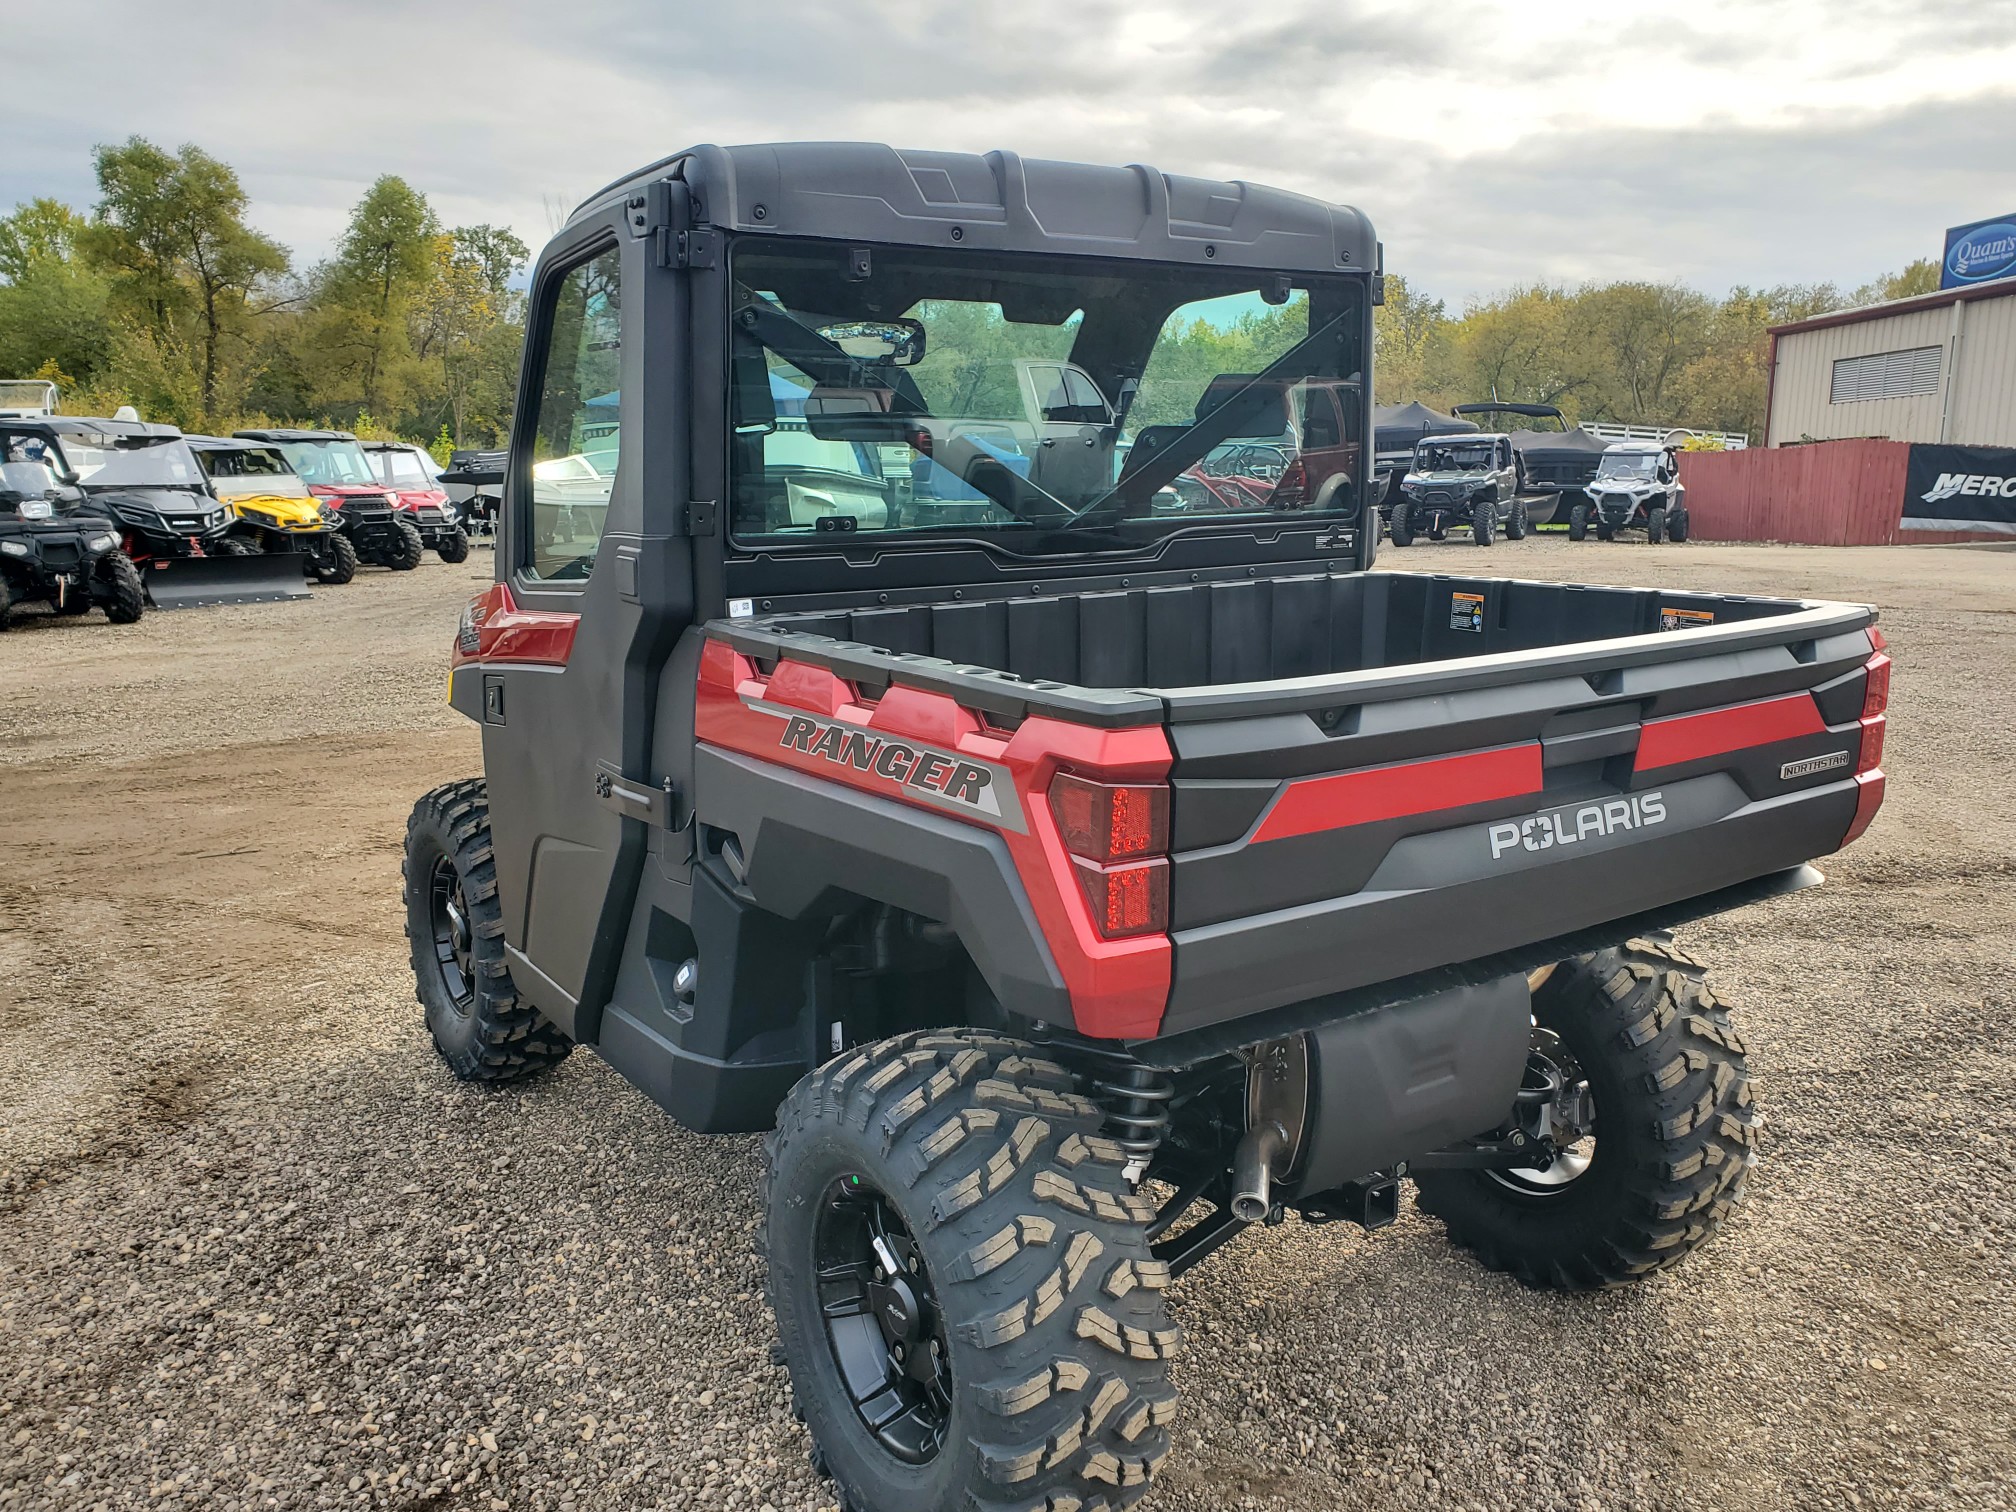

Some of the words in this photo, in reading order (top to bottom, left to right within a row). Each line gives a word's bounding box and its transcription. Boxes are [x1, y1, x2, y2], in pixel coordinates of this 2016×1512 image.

[1957, 236, 2016, 266] Quam's
[1921, 472, 2016, 503] MERC
[779, 714, 992, 804] RANGER
[1785, 754, 1847, 776] NORTHSTAR
[1488, 792, 1666, 859] POLARIS
